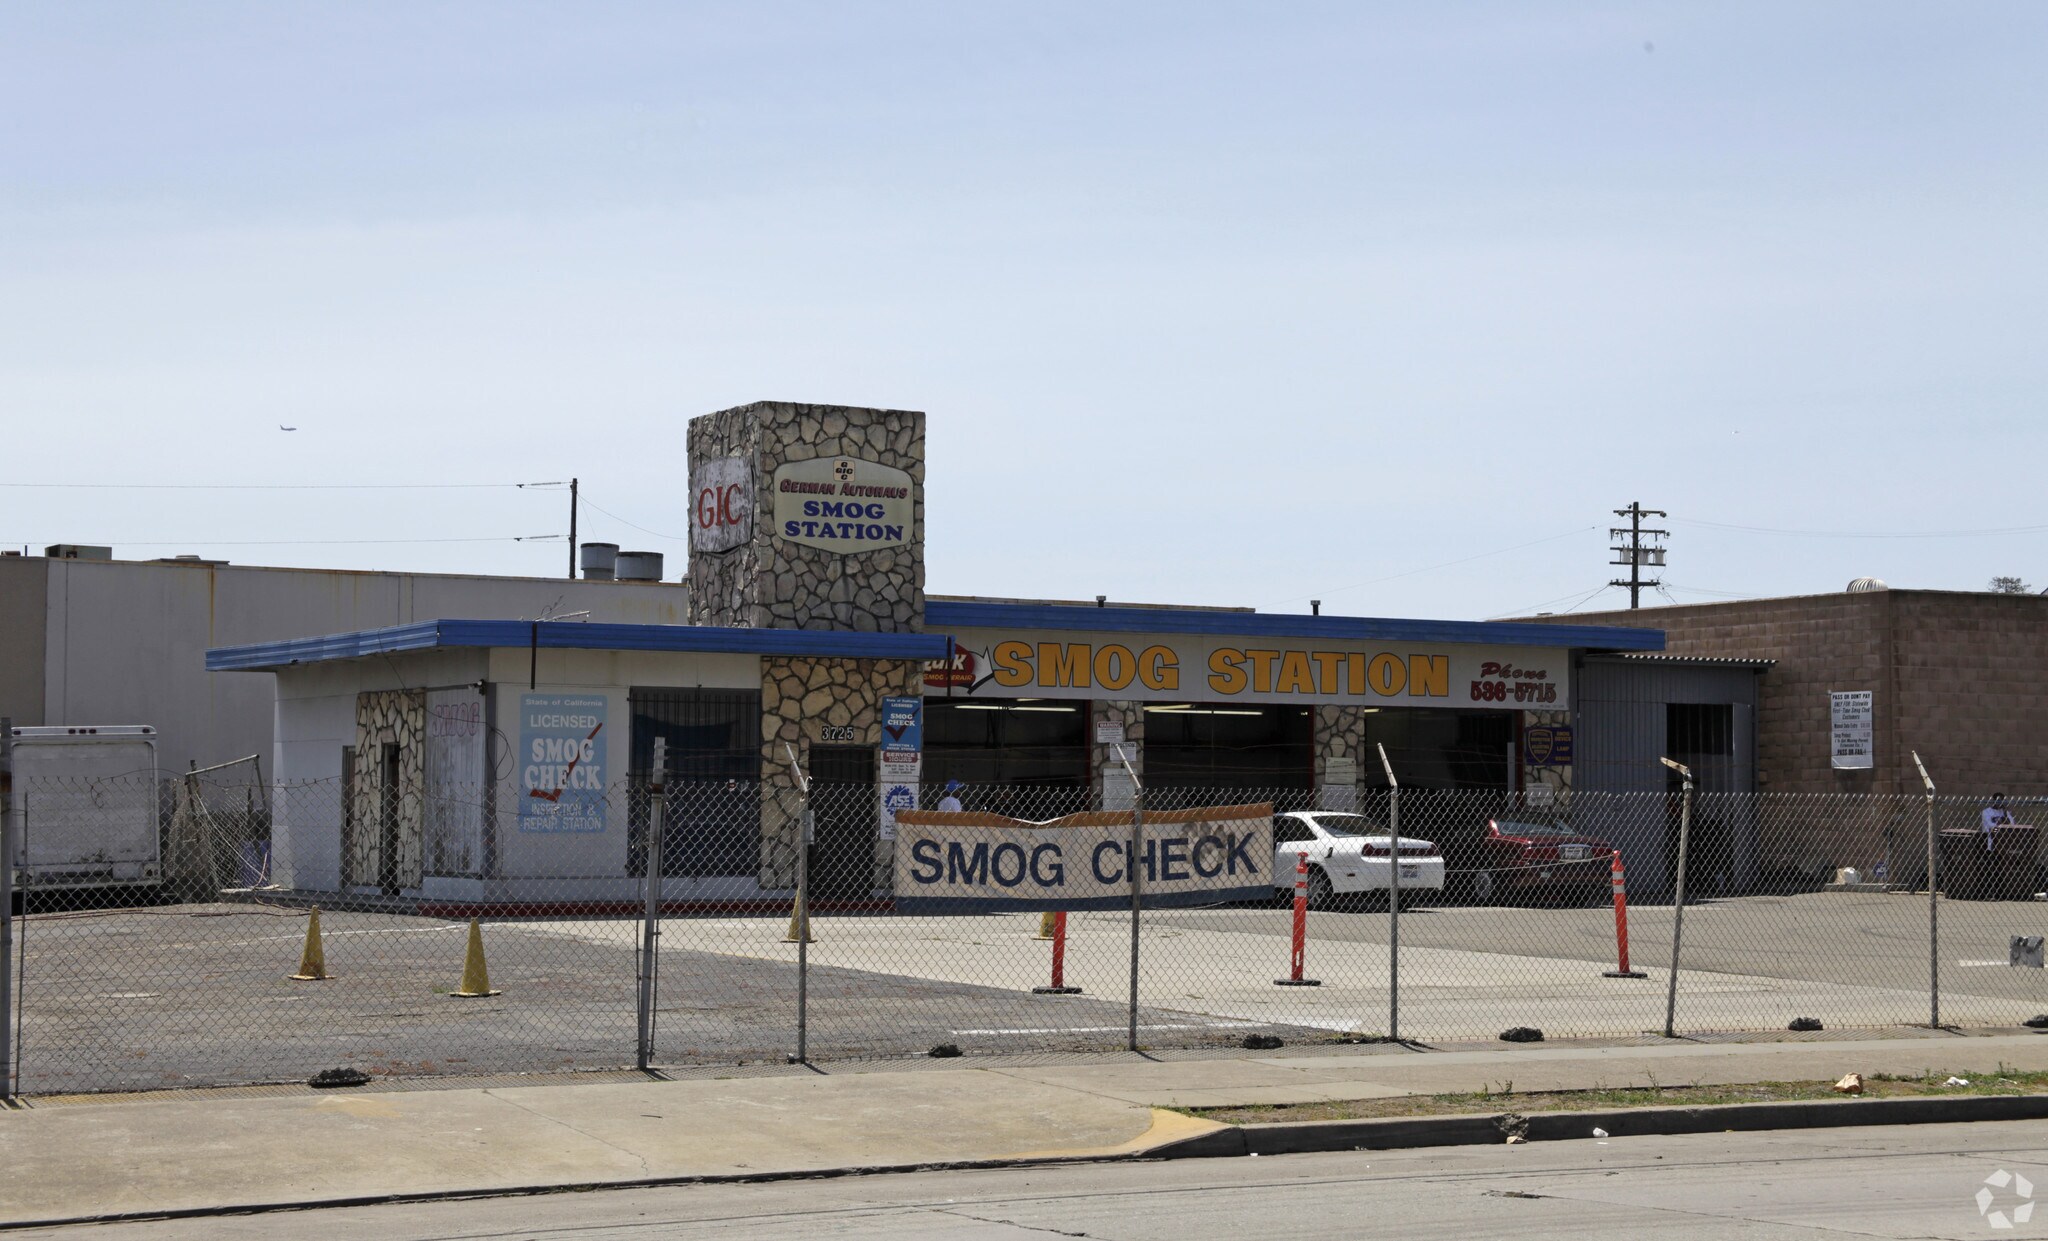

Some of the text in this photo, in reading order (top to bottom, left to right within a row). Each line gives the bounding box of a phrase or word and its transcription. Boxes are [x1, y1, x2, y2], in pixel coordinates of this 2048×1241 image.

[780, 479, 908, 499] GERMAN AUTOHAUS
[698, 483, 743, 530] GIC
[803, 500, 885, 519] SMOG
[785, 520, 904, 541] STATION
[993, 640, 1450, 697] SMOG STATION
[1480, 662, 1547, 680] Phone
[526, 698, 603, 707] State of California
[432, 702, 480, 737] SMOG
[530, 714, 597, 728] LICENSED
[887, 719, 916, 727] CHECK
[821, 726, 855, 740] 3725
[531, 737, 595, 763] SMOG
[524, 764, 602, 790] CHECK
[531, 802, 597, 816] INSPECTION &
[523, 816, 602, 830] REPAIR STATION
[911, 832, 1259, 888] SMOG CHECK
